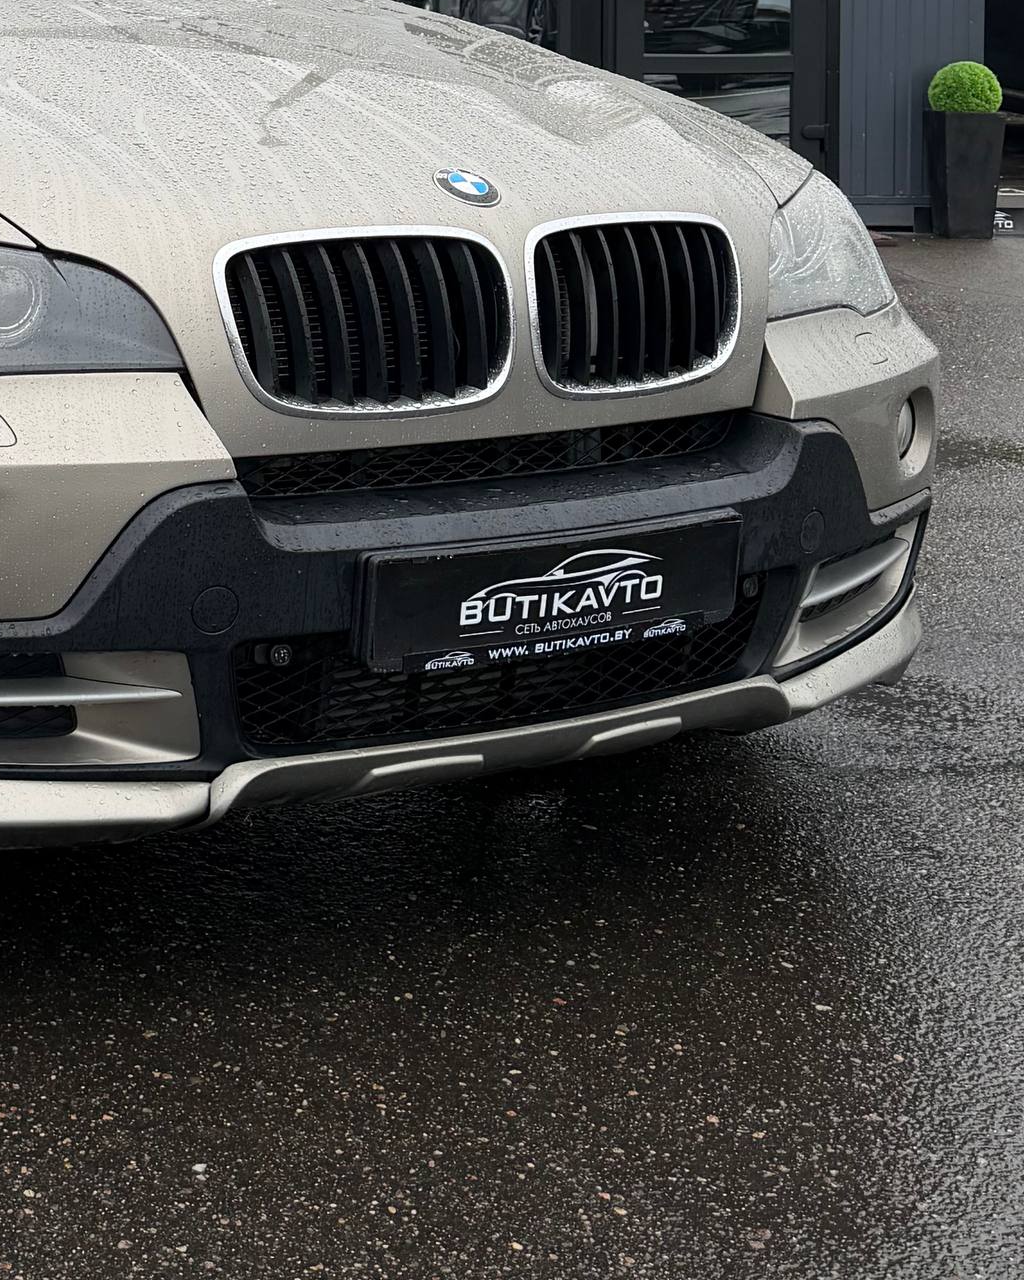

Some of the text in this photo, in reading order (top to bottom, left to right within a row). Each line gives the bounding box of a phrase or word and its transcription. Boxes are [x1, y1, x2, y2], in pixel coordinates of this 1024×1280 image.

[459, 574, 663, 626] BUTIKAVTO
[515, 612, 612, 635] СЕТЬ АВТОХАУСОВ
[535, 628, 633, 653] BUTIKAVTO.BY
[425, 658, 475, 670] BUTIKAVTO
